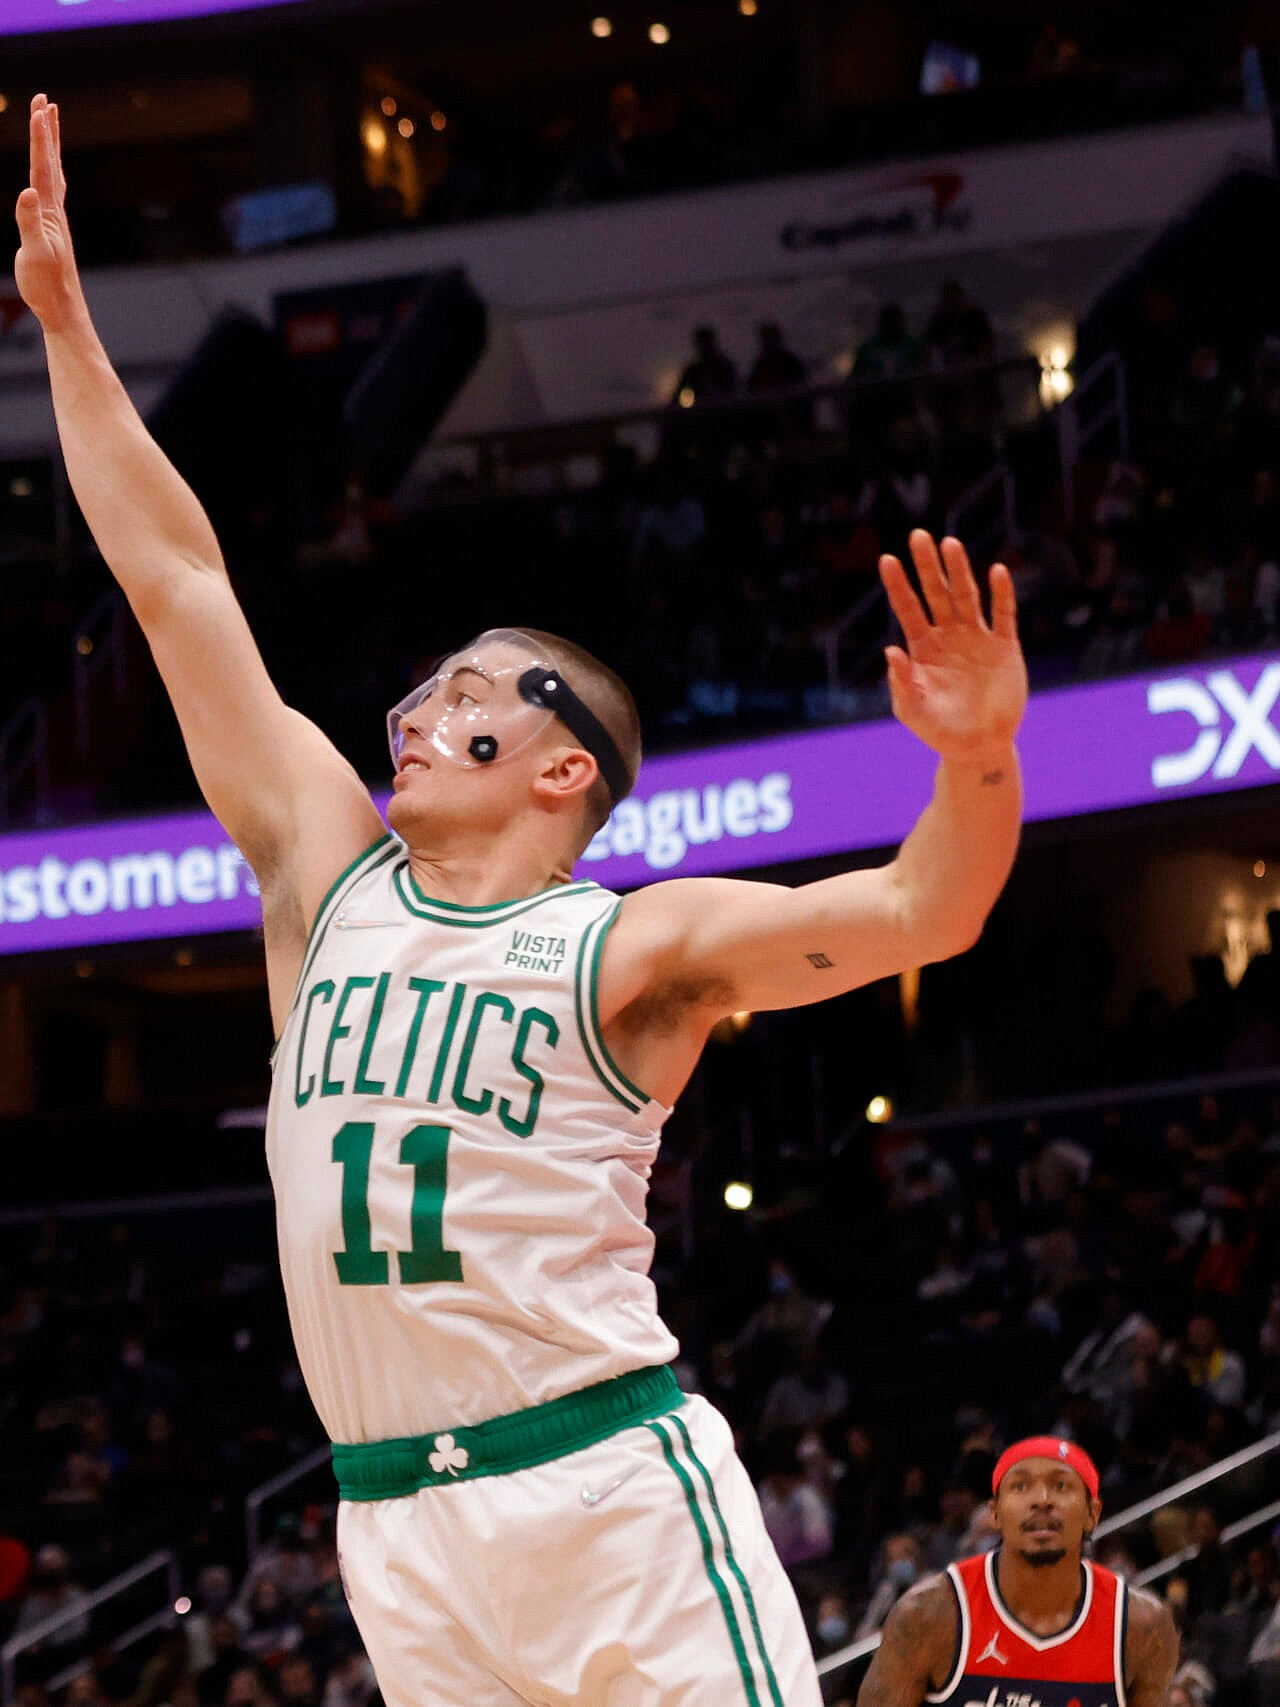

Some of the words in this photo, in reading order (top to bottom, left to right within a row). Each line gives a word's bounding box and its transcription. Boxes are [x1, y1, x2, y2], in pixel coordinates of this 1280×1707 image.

[504, 951, 563, 974] PRINT
[512, 930, 566, 958] VISTA
[295, 972, 560, 1138] CELTICS
[332, 1122, 464, 1285] 11
